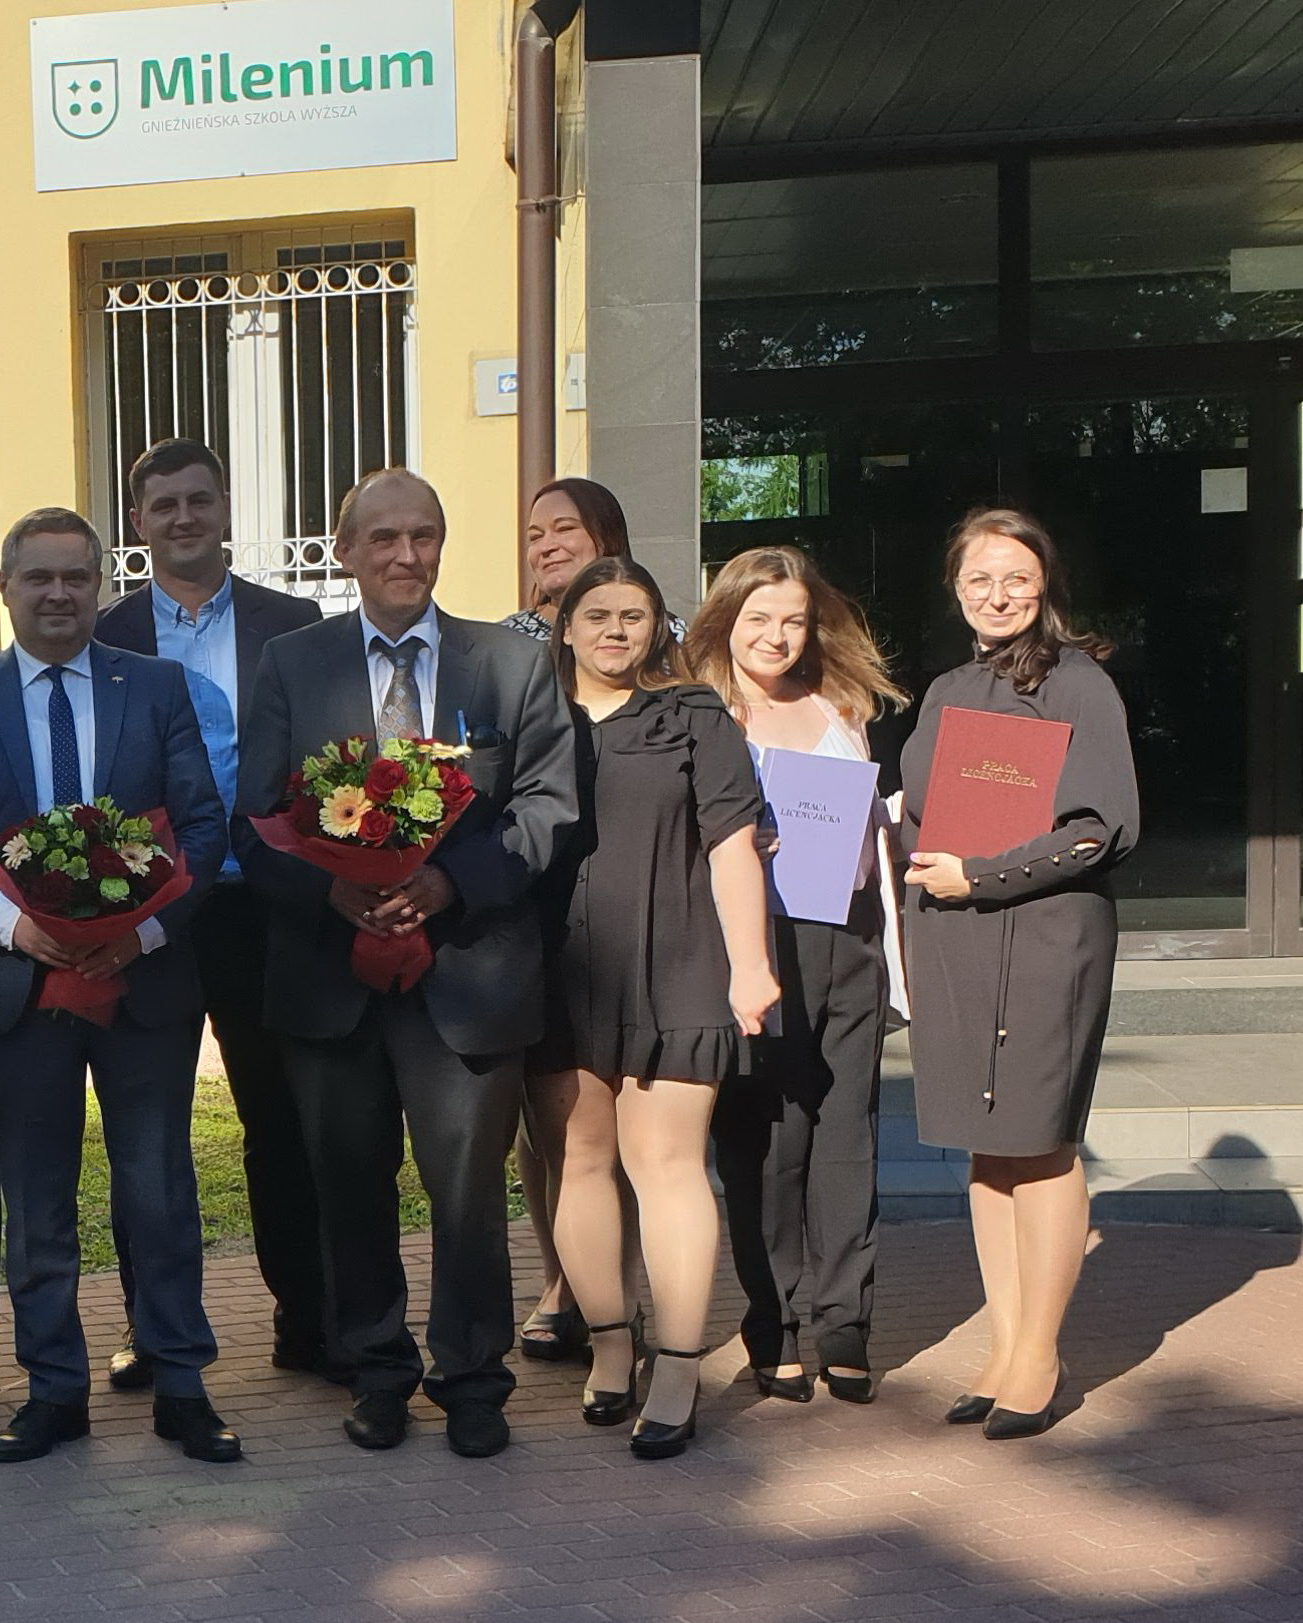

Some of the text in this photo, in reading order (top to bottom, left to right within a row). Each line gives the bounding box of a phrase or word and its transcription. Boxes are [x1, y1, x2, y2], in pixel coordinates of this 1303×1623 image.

[140, 43, 433, 109] Milenium
[300, 104, 358, 121] WYŻSZA
[798, 801, 827, 812] PRACA
[780, 808, 841, 823] LICENCJACKA
